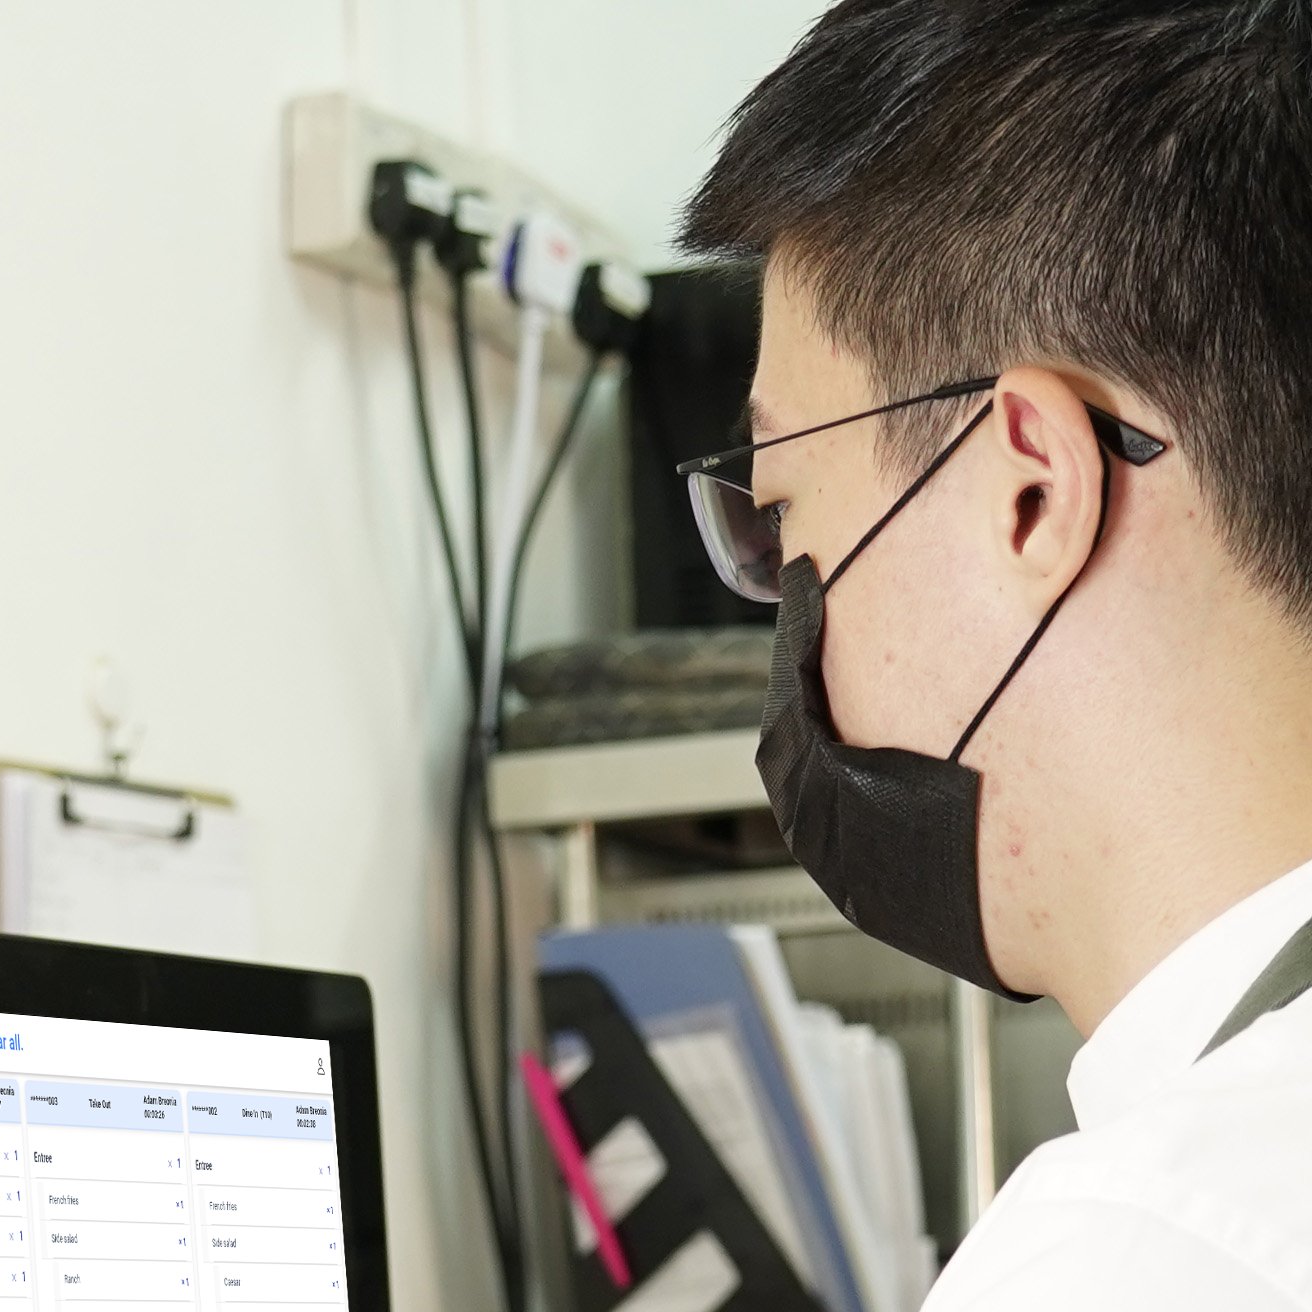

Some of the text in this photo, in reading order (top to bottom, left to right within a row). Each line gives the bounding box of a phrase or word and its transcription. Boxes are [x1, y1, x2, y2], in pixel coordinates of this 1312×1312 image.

[9, 1034, 23, 1051] all.
[89, 1099, 111, 1108] Take Out
[144, 1095, 157, 1104] Adam
[296, 1106, 308, 1114] Adam
[34, 1152, 52, 1163] Entree
[196, 1160, 212, 1170] Entree
